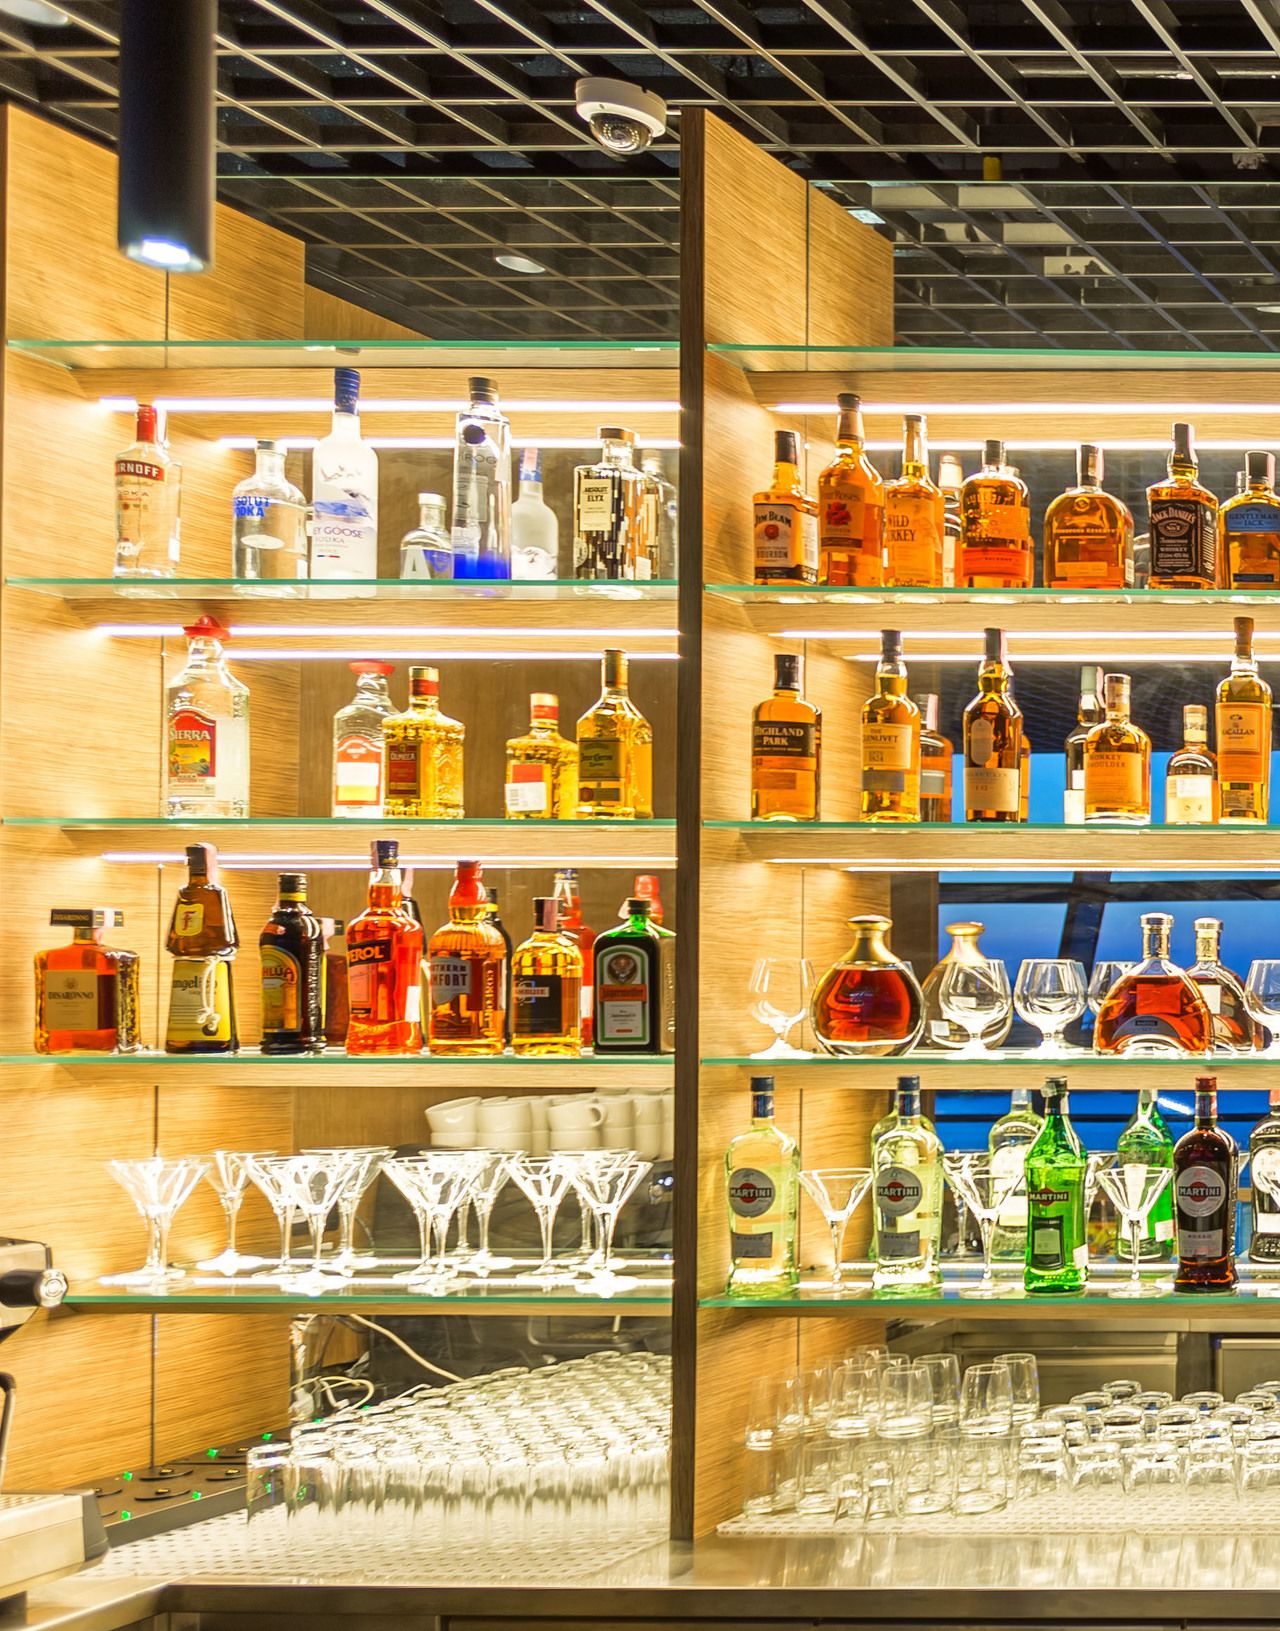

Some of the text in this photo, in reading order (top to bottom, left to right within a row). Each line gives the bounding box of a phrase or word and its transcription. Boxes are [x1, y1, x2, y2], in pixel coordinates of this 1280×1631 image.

[587, 494, 604, 503] ELYX
[768, 511, 792, 527] BEAM
[1151, 506, 1196, 524] JACK DANIEL'S
[324, 527, 364, 539] GOOSE
[762, 736, 788, 746] PARK
[389, 752, 416, 761] OLMECA
[47, 991, 94, 1000] DISARONNO
[730, 1187, 771, 1198] MARTINI
[877, 1186, 919, 1197] MARTINI
[1029, 1192, 1068, 1201] MARTINI
[1179, 1186, 1221, 1197] MARTINI
